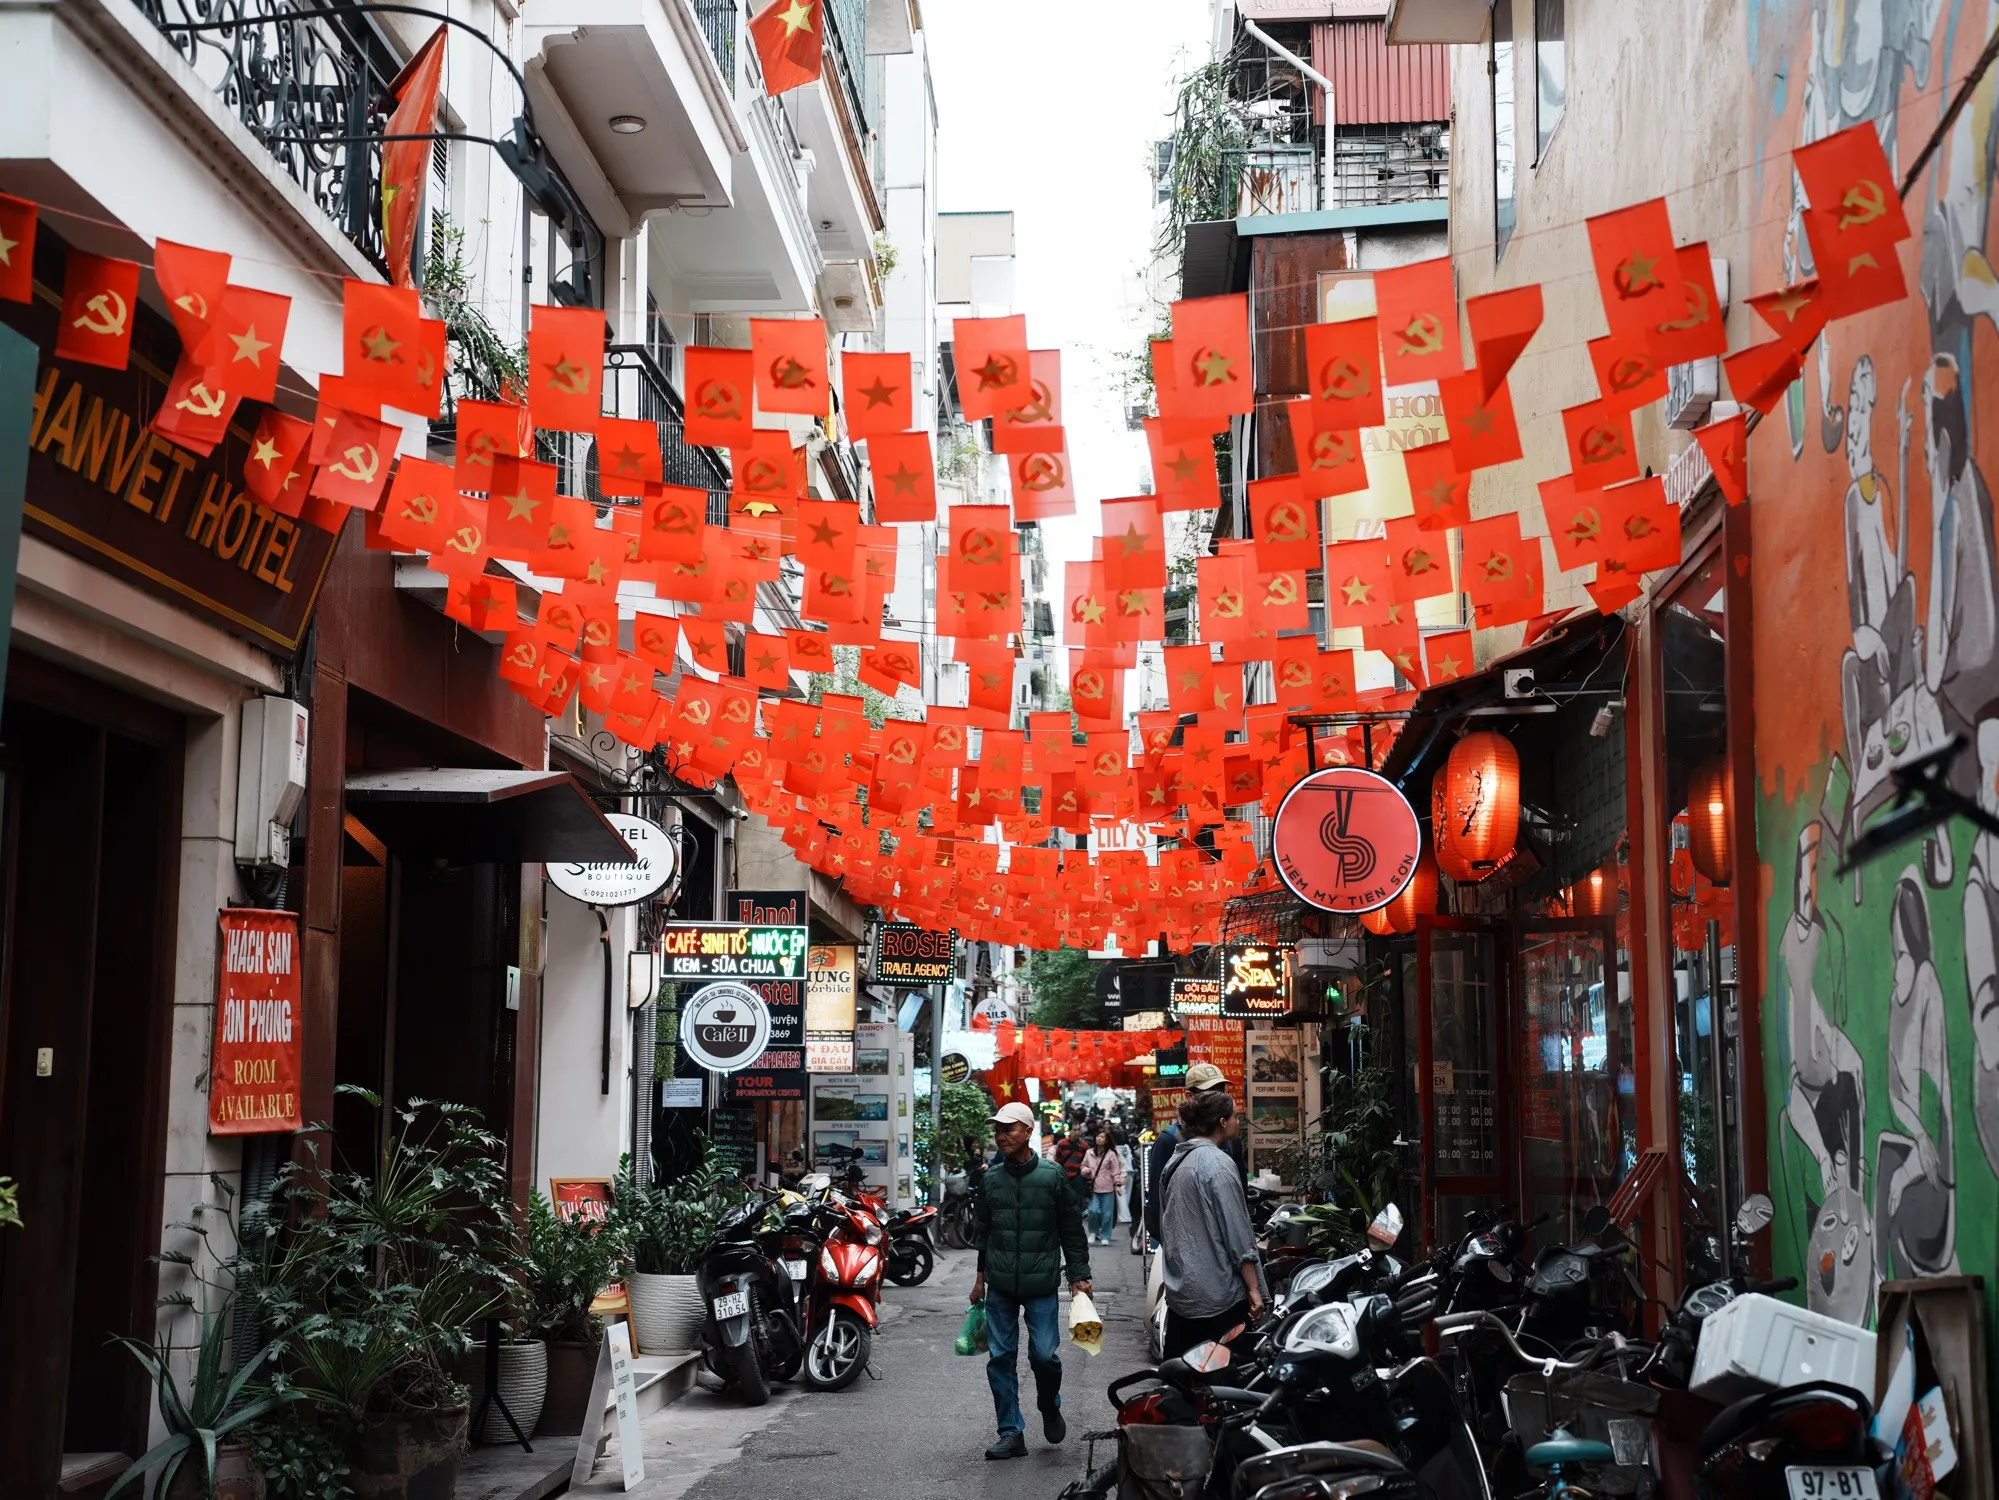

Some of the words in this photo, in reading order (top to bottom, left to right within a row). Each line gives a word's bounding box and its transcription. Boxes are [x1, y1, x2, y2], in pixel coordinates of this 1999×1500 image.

[187, 472, 301, 594] HOTEL
[587, 873, 651, 881] BOUTIQUE
[1313, 889, 1339, 905] MY
[738, 898, 797, 925] Hanoi
[881, 930, 951, 959] ROSE
[266, 931, 292, 985] SẠN
[673, 957, 701, 974] KEM
[739, 958, 776, 974] CHUA
[881, 961, 913, 976] TRAVEL
[913, 963, 950, 977] AGENCY
[1234, 961, 1277, 987] SPA
[248, 988, 292, 1043] PHÒNG
[702, 1025, 737, 1043] Café
[233, 1059, 277, 1086] ROOM
[735, 1076, 774, 1088] TOUR
[216, 1093, 296, 1122] AVAILABLE
[1453, 1138, 1478, 1146] SUNDAY
[1438, 1149, 1461, 1159] 10:00
[1470, 1150, 1494, 1159] 22:00
[718, 1293, 742, 1308] 29-H2
[716, 1303, 746, 1319] 310.54
[1801, 1471, 1864, 1497] 97-B1
